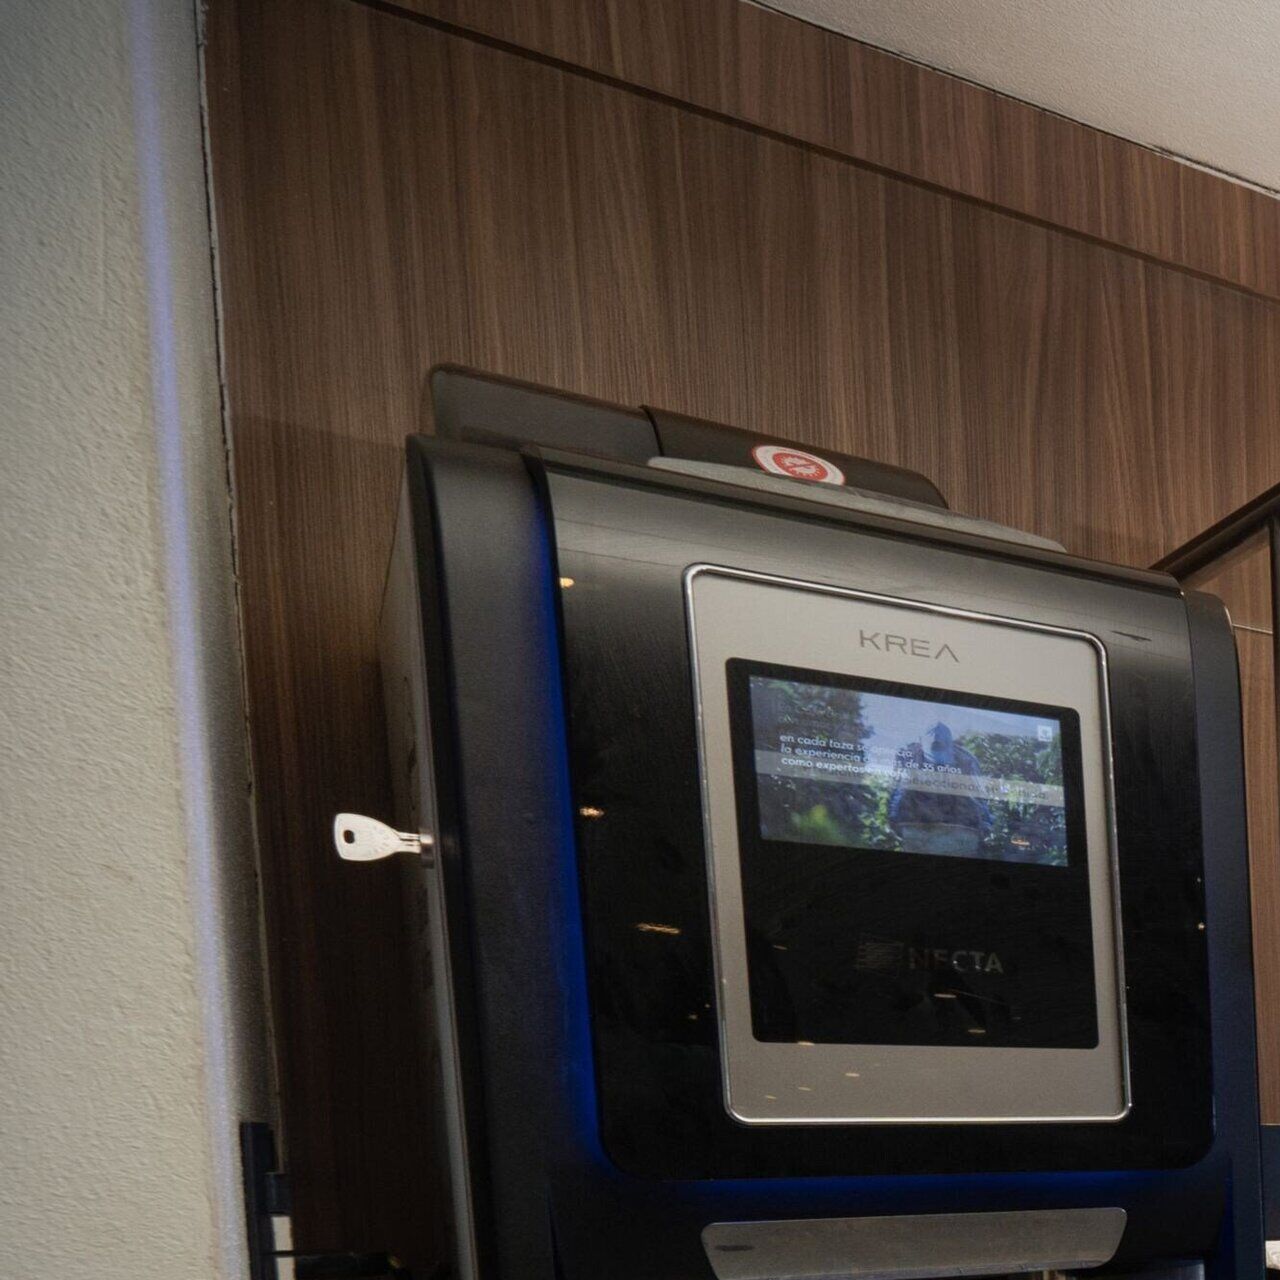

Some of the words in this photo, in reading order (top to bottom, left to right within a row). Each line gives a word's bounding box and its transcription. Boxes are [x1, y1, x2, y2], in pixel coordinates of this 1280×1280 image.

[859, 629, 960, 663] KREA
[779, 735, 795, 743] en
[797, 737, 826, 747] cada
[829, 740, 854, 750] taza
[780, 743, 792, 754] la
[794, 748, 861, 763] experiencia
[937, 764, 962, 774] años
[780, 758, 813, 768] como
